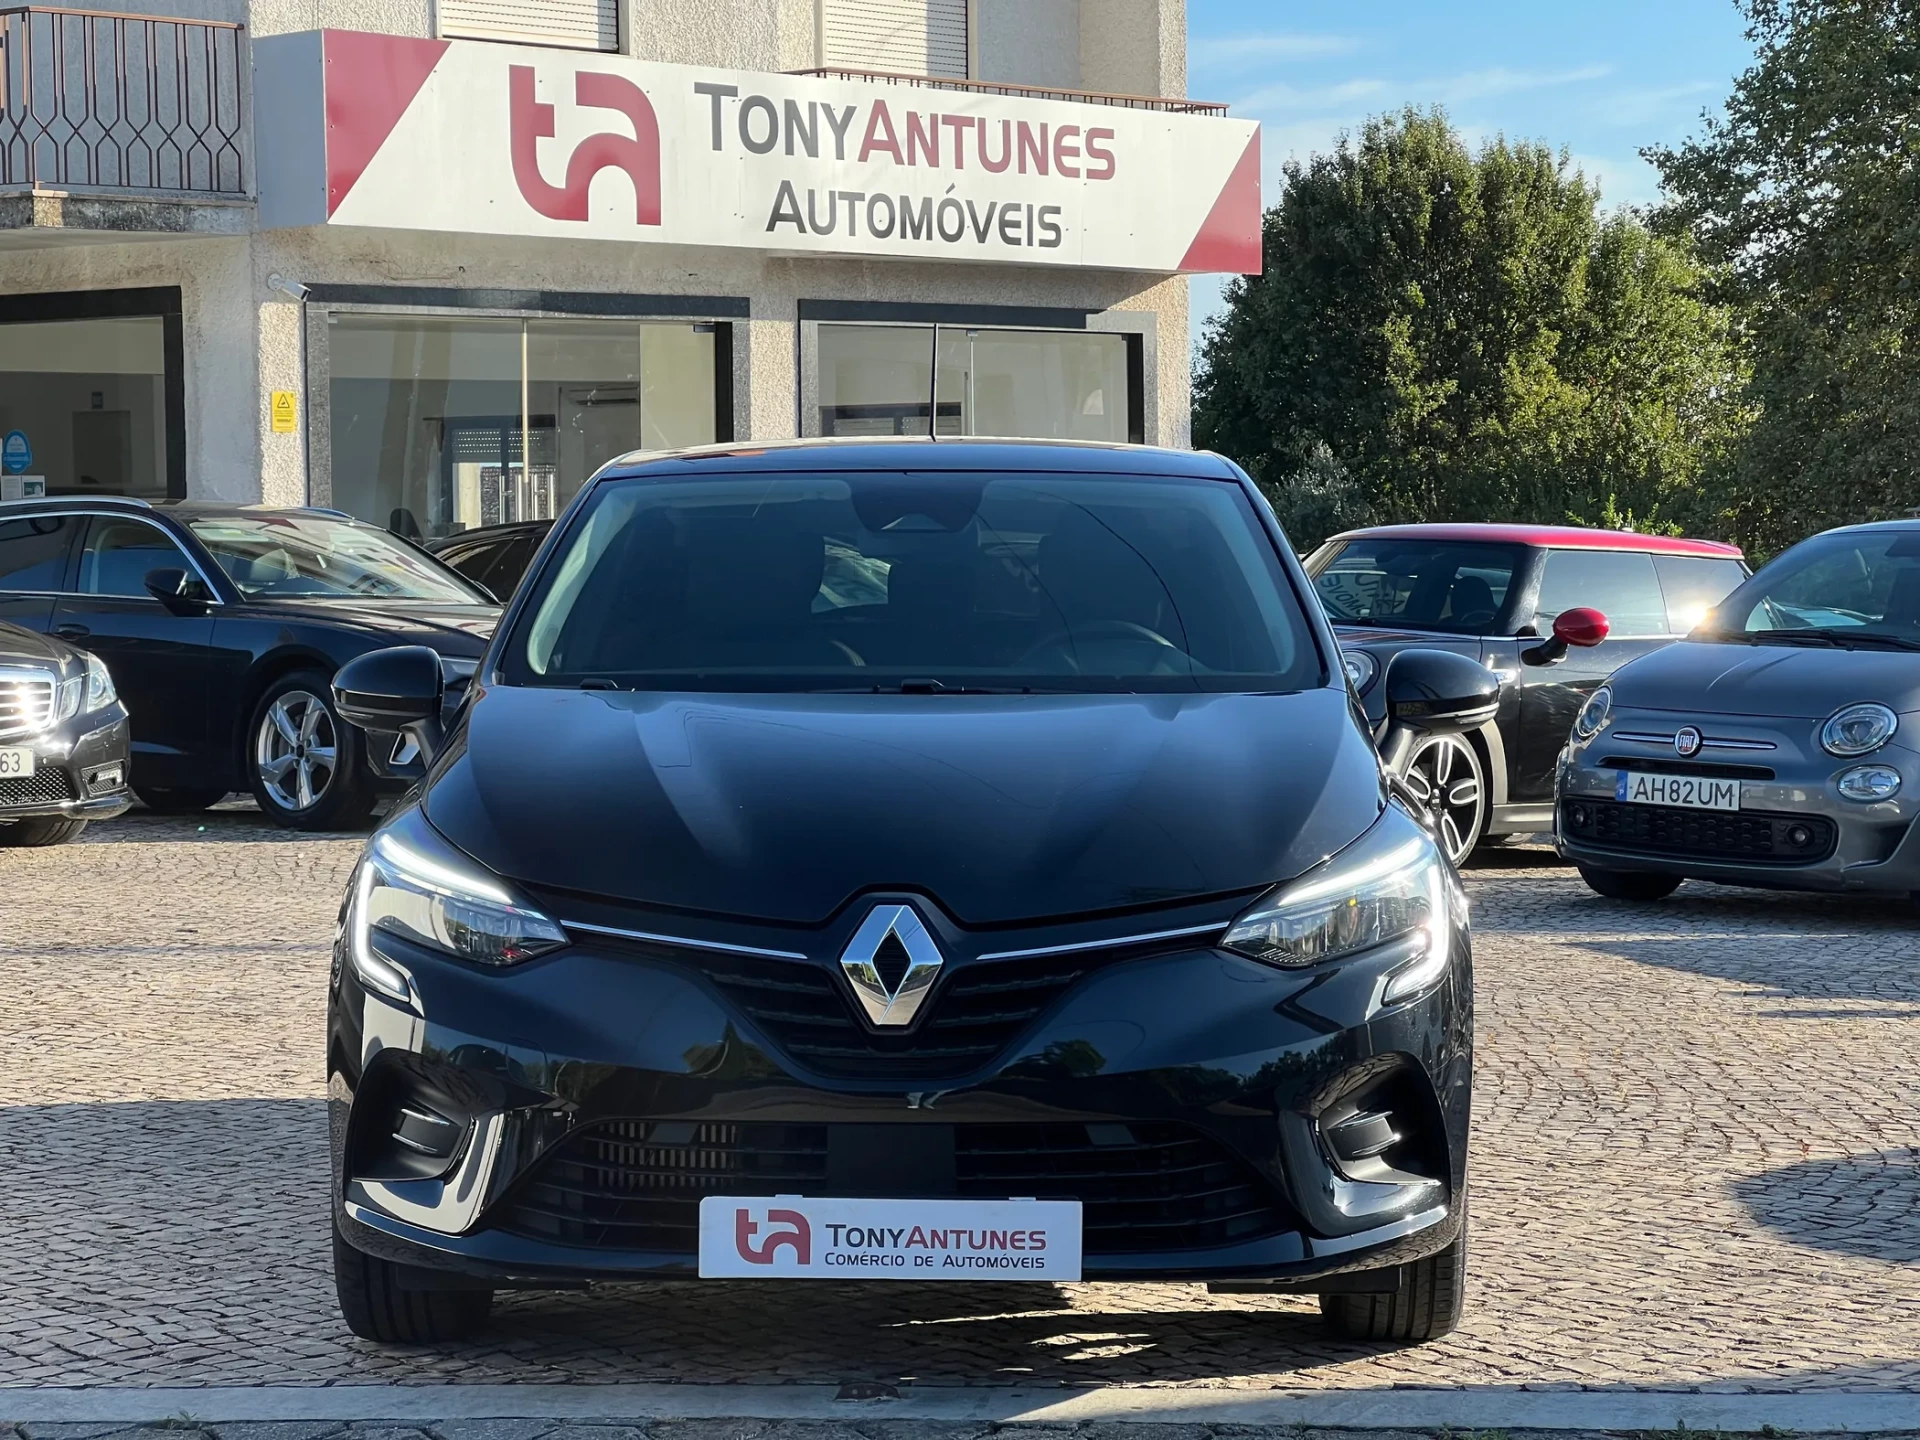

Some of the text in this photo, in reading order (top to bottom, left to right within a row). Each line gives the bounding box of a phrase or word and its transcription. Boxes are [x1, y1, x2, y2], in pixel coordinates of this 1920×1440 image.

[765, 180, 1062, 248] AUTOMÓVEIS
[1680, 734, 1695, 748] FIAT
[1633, 776, 1733, 807] AH82UM
[825, 1251, 1045, 1269] COMÉRCIO DE AUTOMÓVEIS
